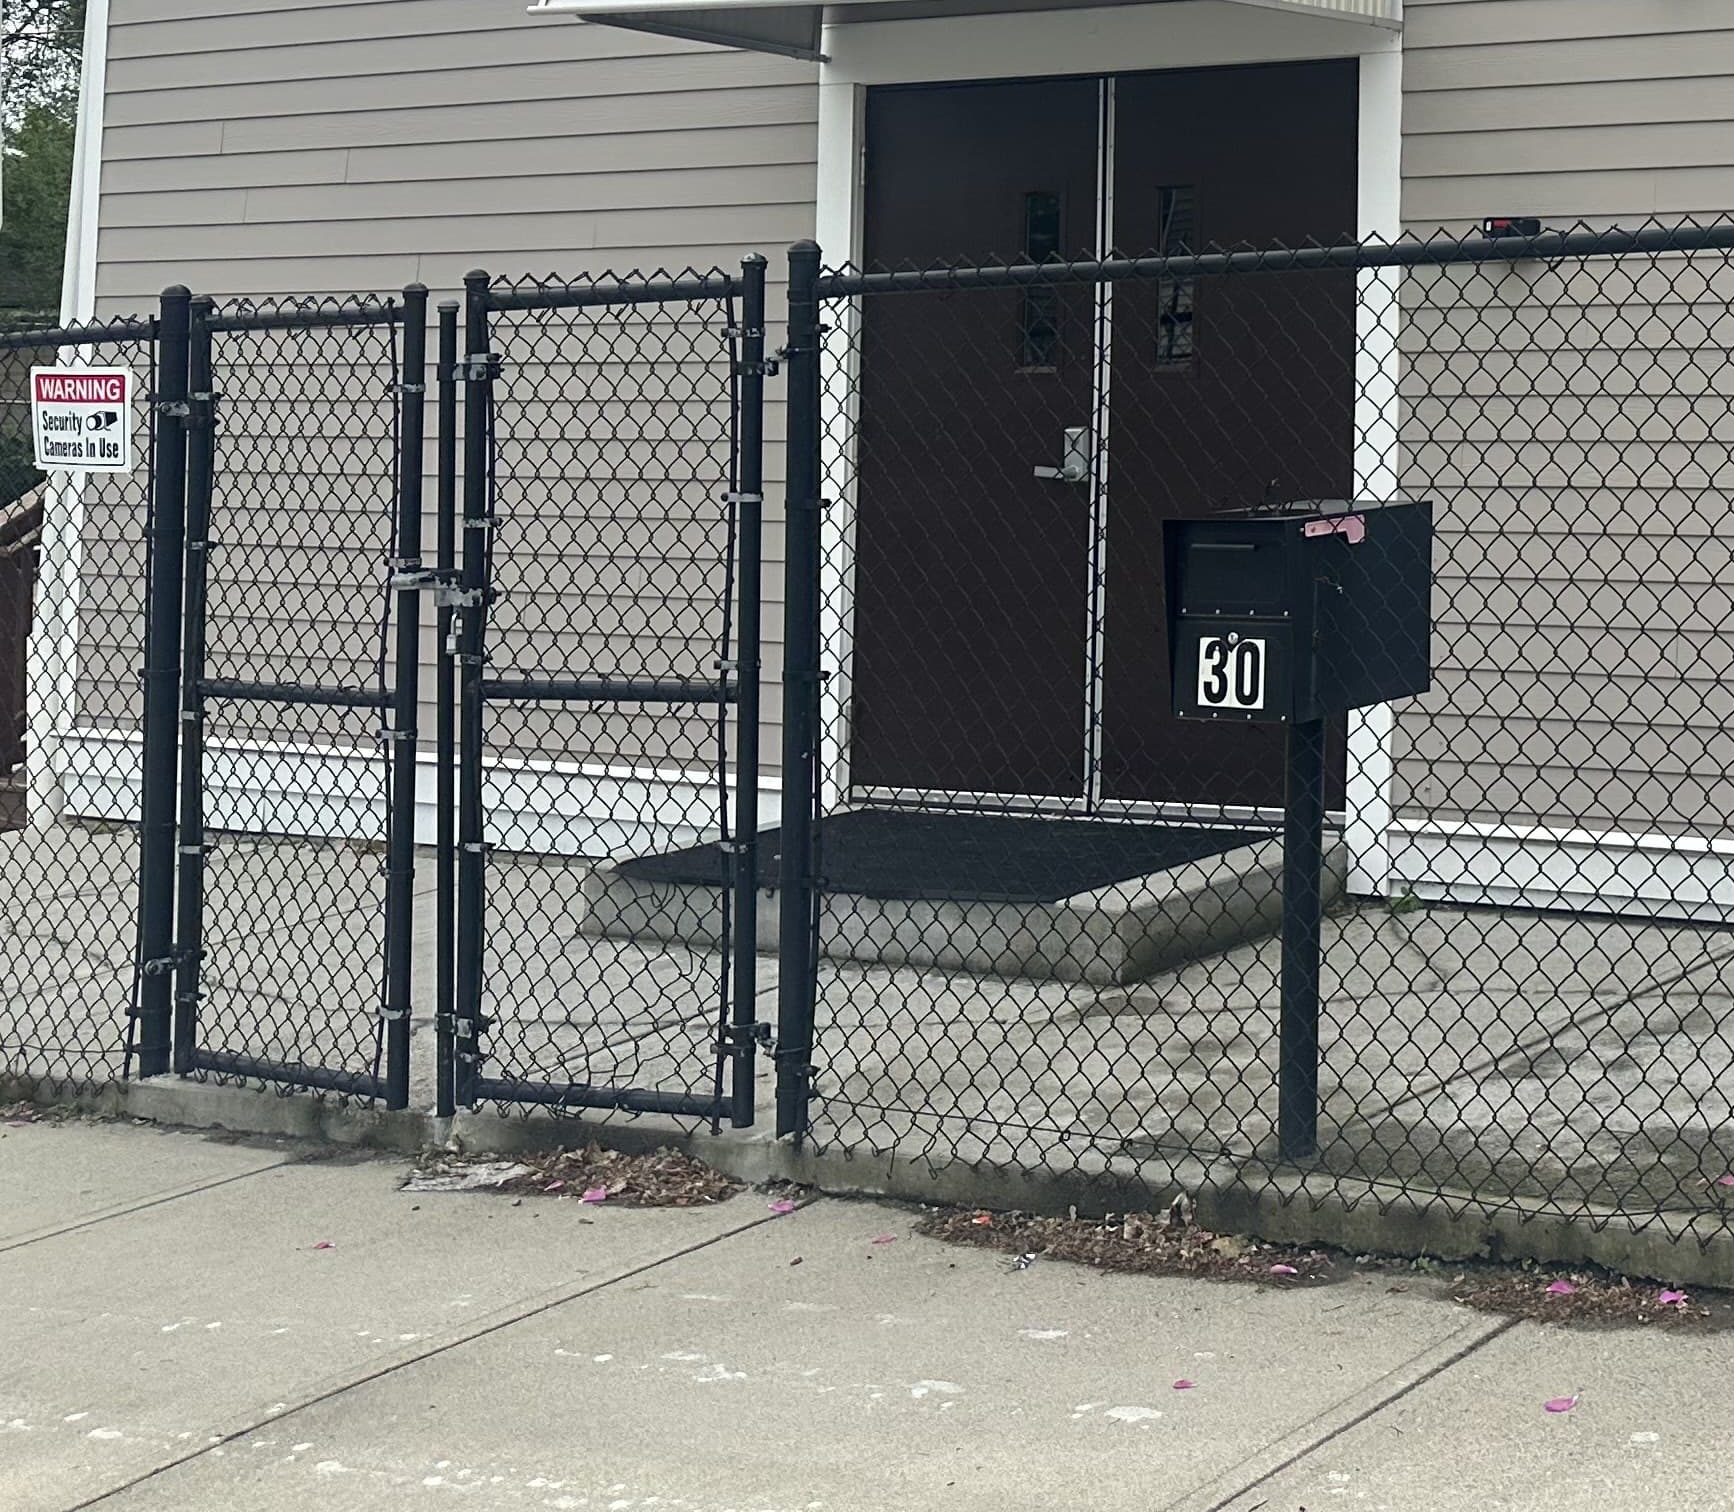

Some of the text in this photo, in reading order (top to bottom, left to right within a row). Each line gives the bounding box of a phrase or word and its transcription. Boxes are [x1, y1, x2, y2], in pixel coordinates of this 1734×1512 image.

[39, 378, 121, 400] WARNING
[42, 410, 83, 436] Security
[43, 435, 119, 459] Cameras In Use
[1203, 640, 1261, 706] 30
